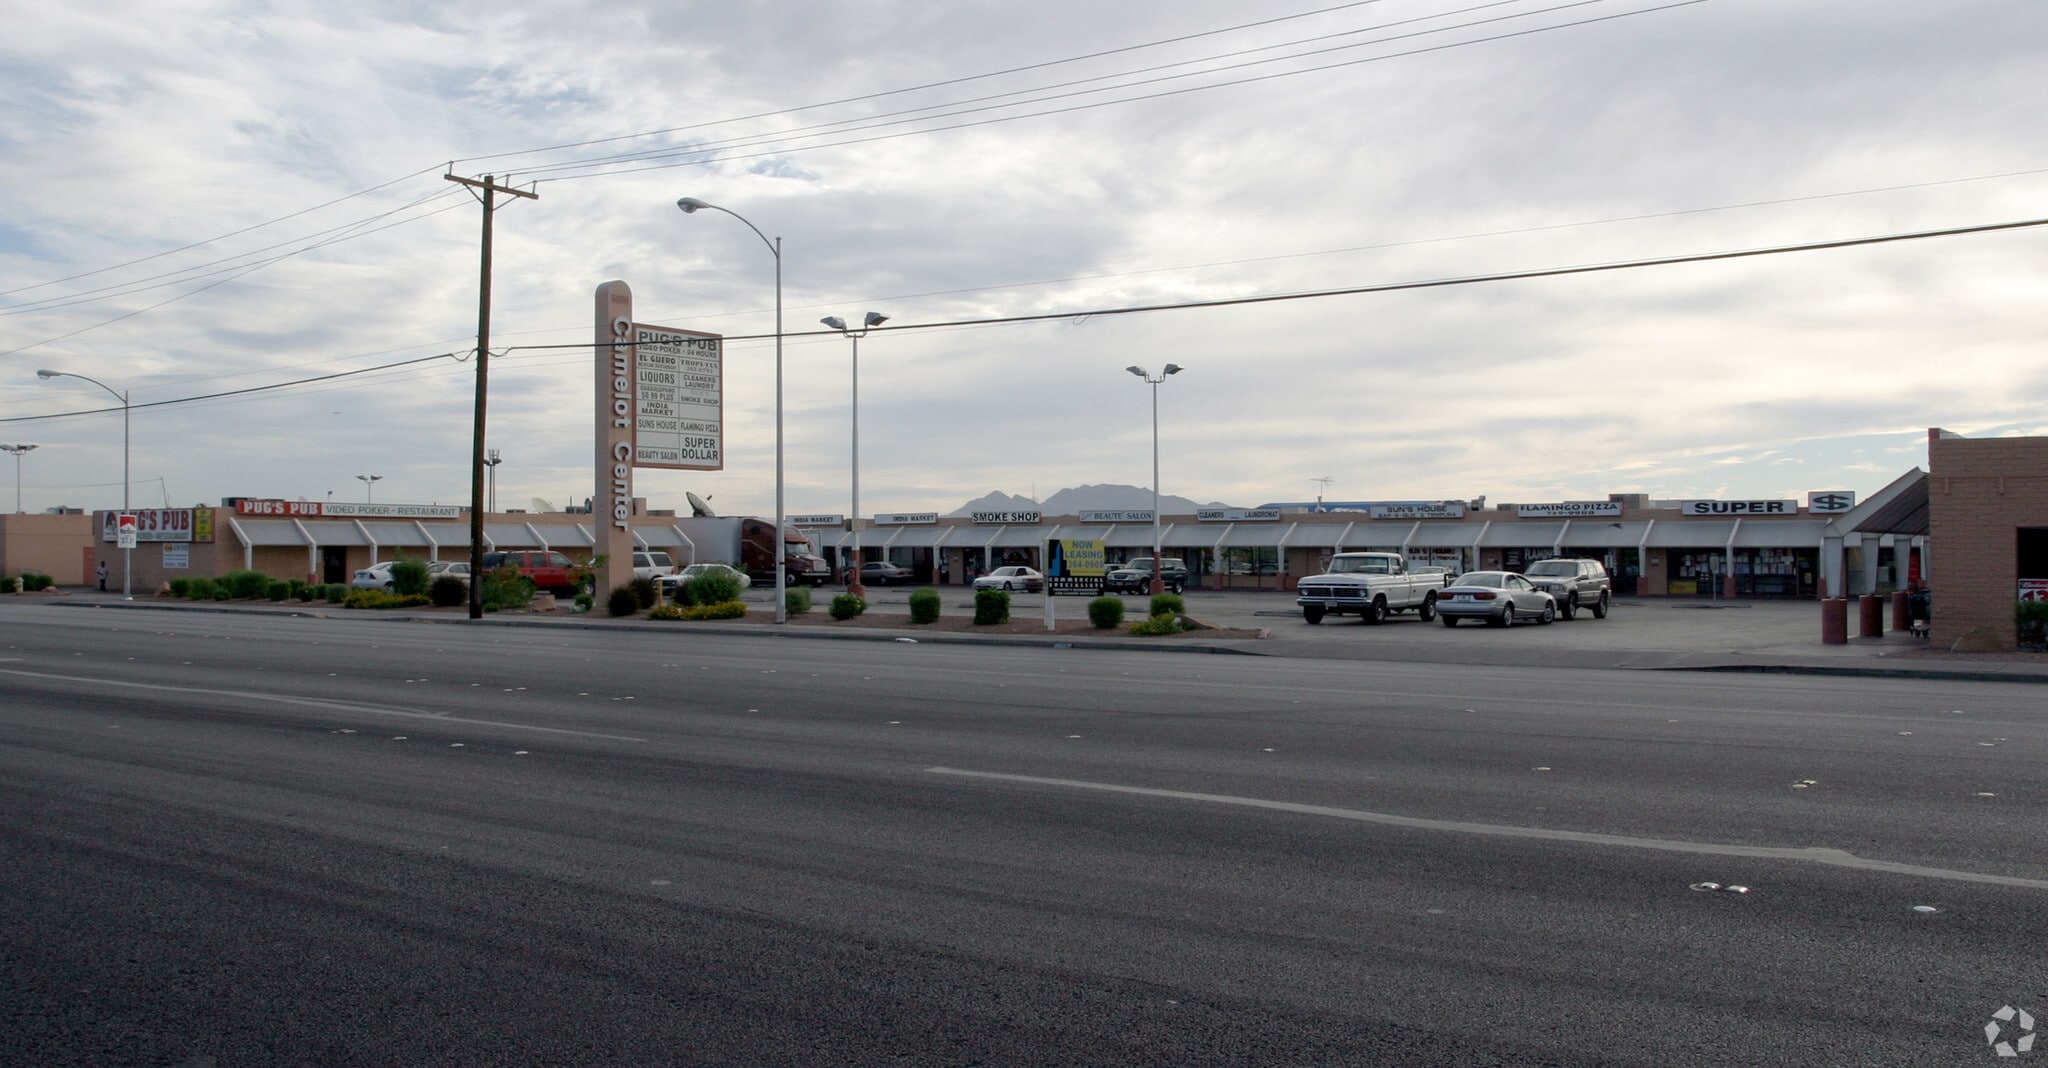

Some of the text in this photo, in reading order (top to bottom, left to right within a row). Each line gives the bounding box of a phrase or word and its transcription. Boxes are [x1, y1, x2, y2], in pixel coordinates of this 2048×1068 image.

[639, 331, 717, 351] PUG'S PUB
[660, 346, 680, 354] POKER
[696, 350, 717, 358] HOURS
[613, 316, 632, 427] Camelot
[640, 371, 675, 384] LIQUORS
[683, 374, 716, 383] CLEANERS
[660, 393, 674, 401] PLUS
[641, 408, 674, 416] MARKET
[656, 420, 677, 430] HOUSE
[705, 424, 719, 433] PIZZA
[684, 437, 715, 449] SUPER
[638, 450, 678, 460] BEAUTY SALON
[681, 449, 719, 461] DOLLAR
[613, 441, 632, 532] Center
[244, 501, 318, 514] PUG'S PUB
[326, 505, 355, 514] VIDEO
[358, 506, 389, 515] POKER
[398, 507, 455, 516] RESTAURANT
[1694, 502, 1784, 513] SUPER
[162, 511, 189, 530] PUB
[973, 512, 1039, 522] SMOKE SHOP
[1072, 541, 1093, 549] NOW
[1065, 551, 1103, 559] LEASING
